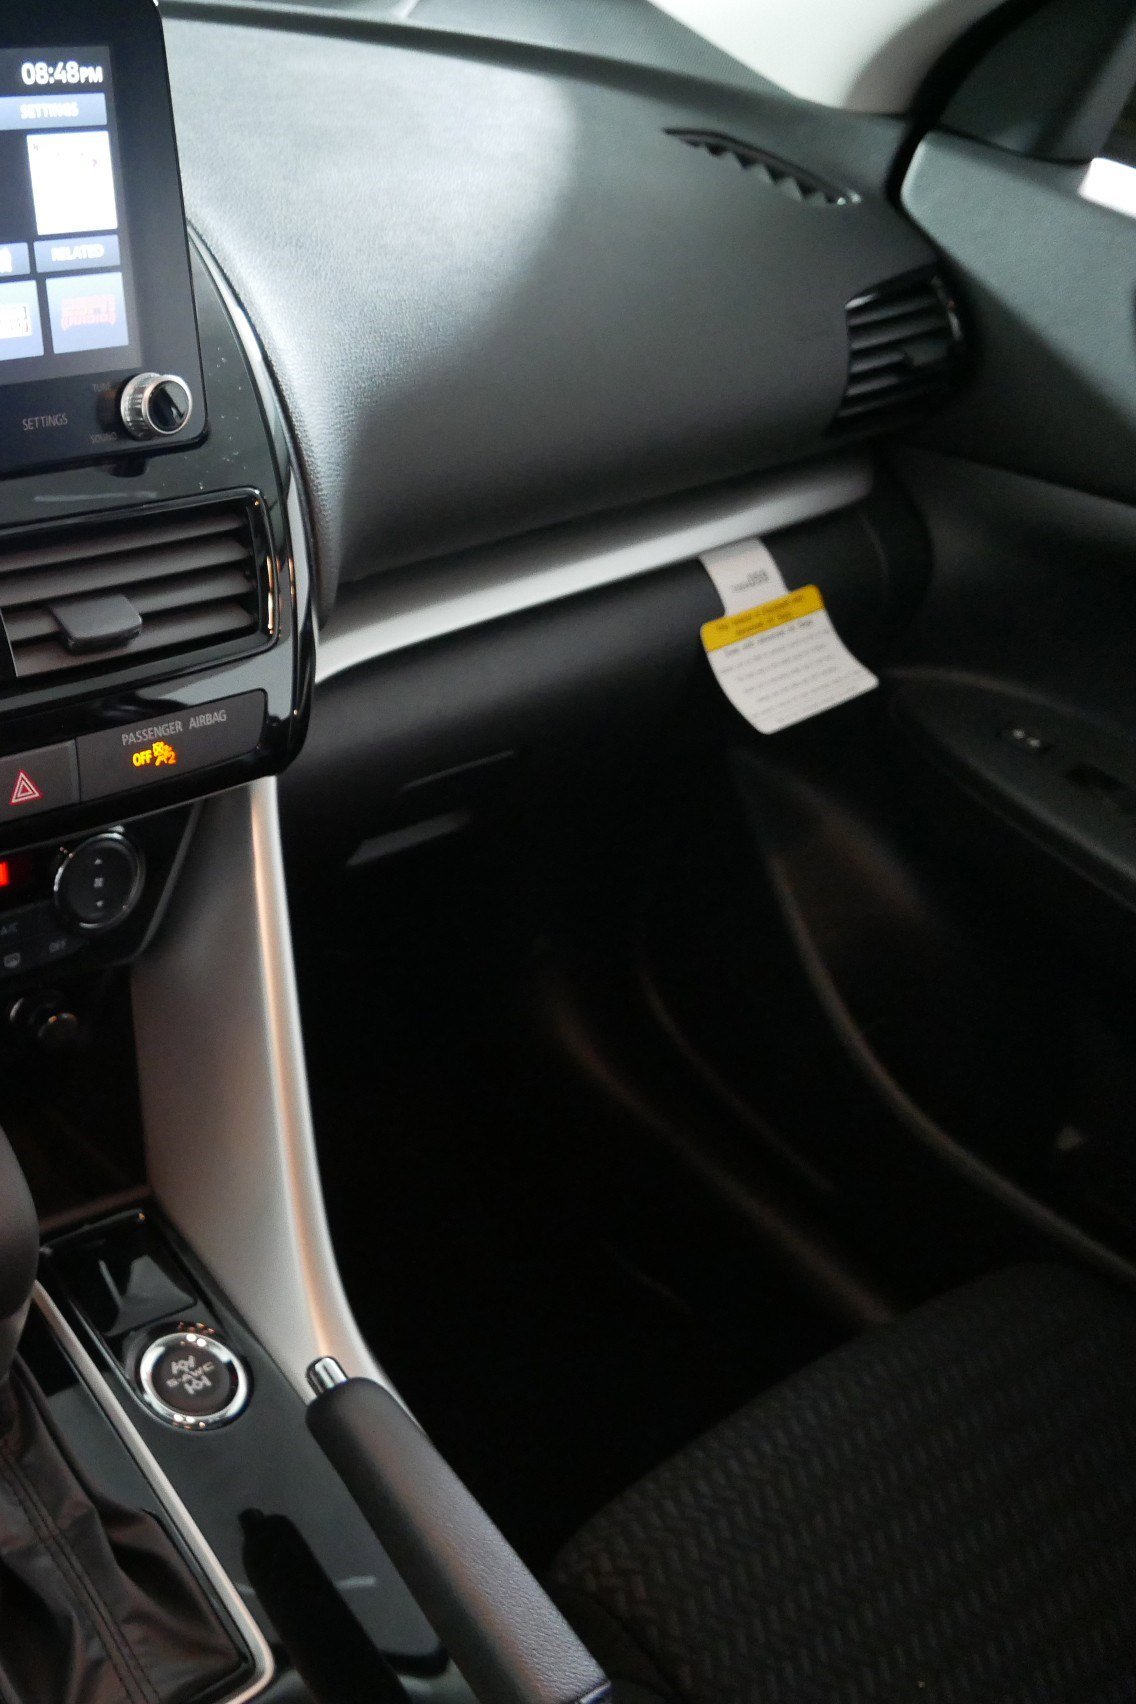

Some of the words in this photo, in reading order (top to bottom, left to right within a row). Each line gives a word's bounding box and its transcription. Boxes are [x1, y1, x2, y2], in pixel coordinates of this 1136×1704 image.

[22, 413, 68, 431] SETTINGS
[121, 720, 183, 747] PASSENGER
[188, 709, 227, 730] AIRBAG
[132, 749, 152, 767] OFF
